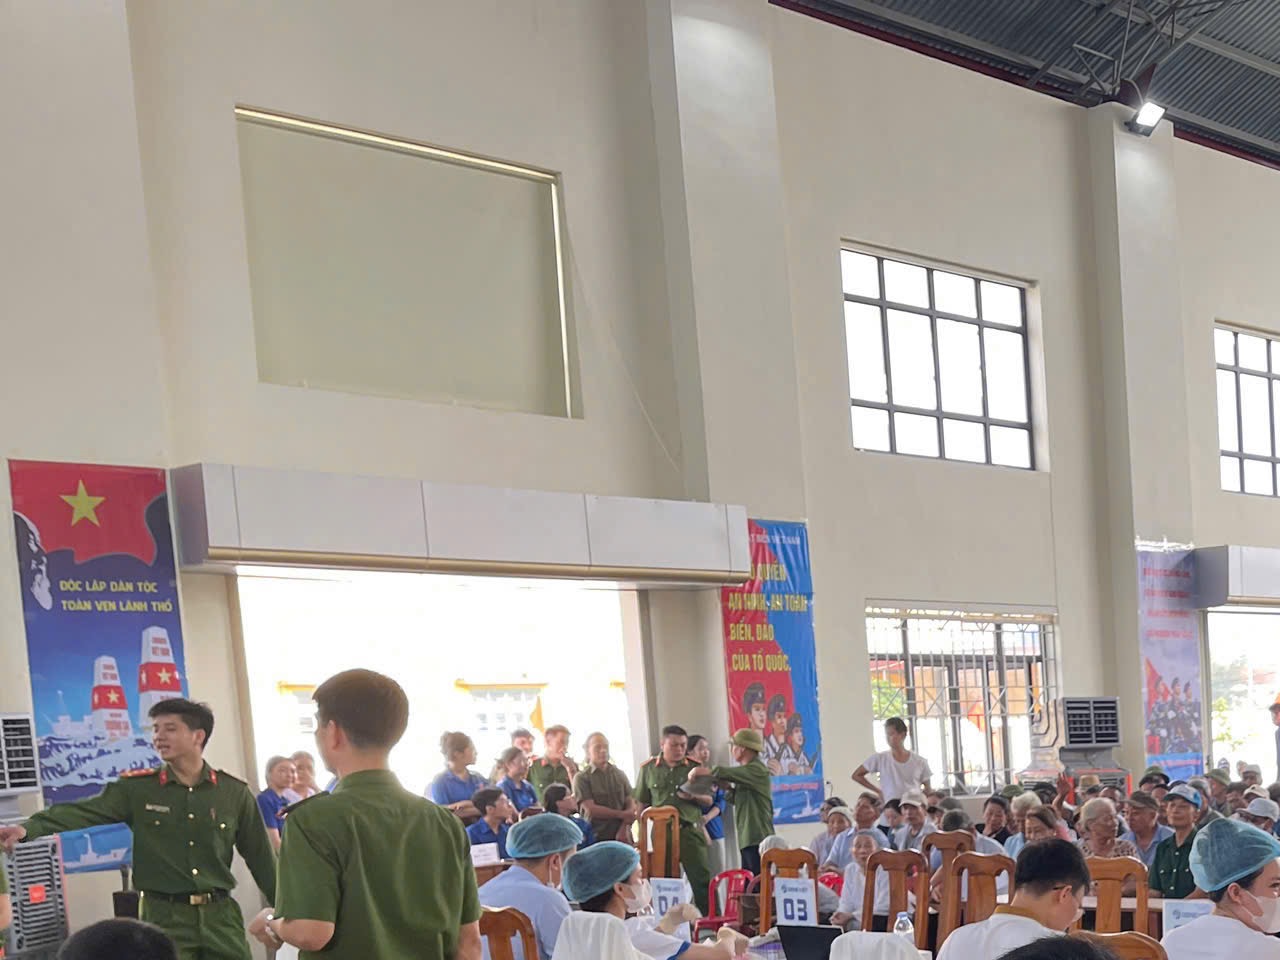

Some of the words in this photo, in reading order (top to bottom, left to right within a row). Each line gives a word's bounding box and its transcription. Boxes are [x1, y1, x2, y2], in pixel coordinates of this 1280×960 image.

[728, 592, 742, 612] AN
[732, 647, 751, 672] CỦA
[783, 898, 808, 921] 03
